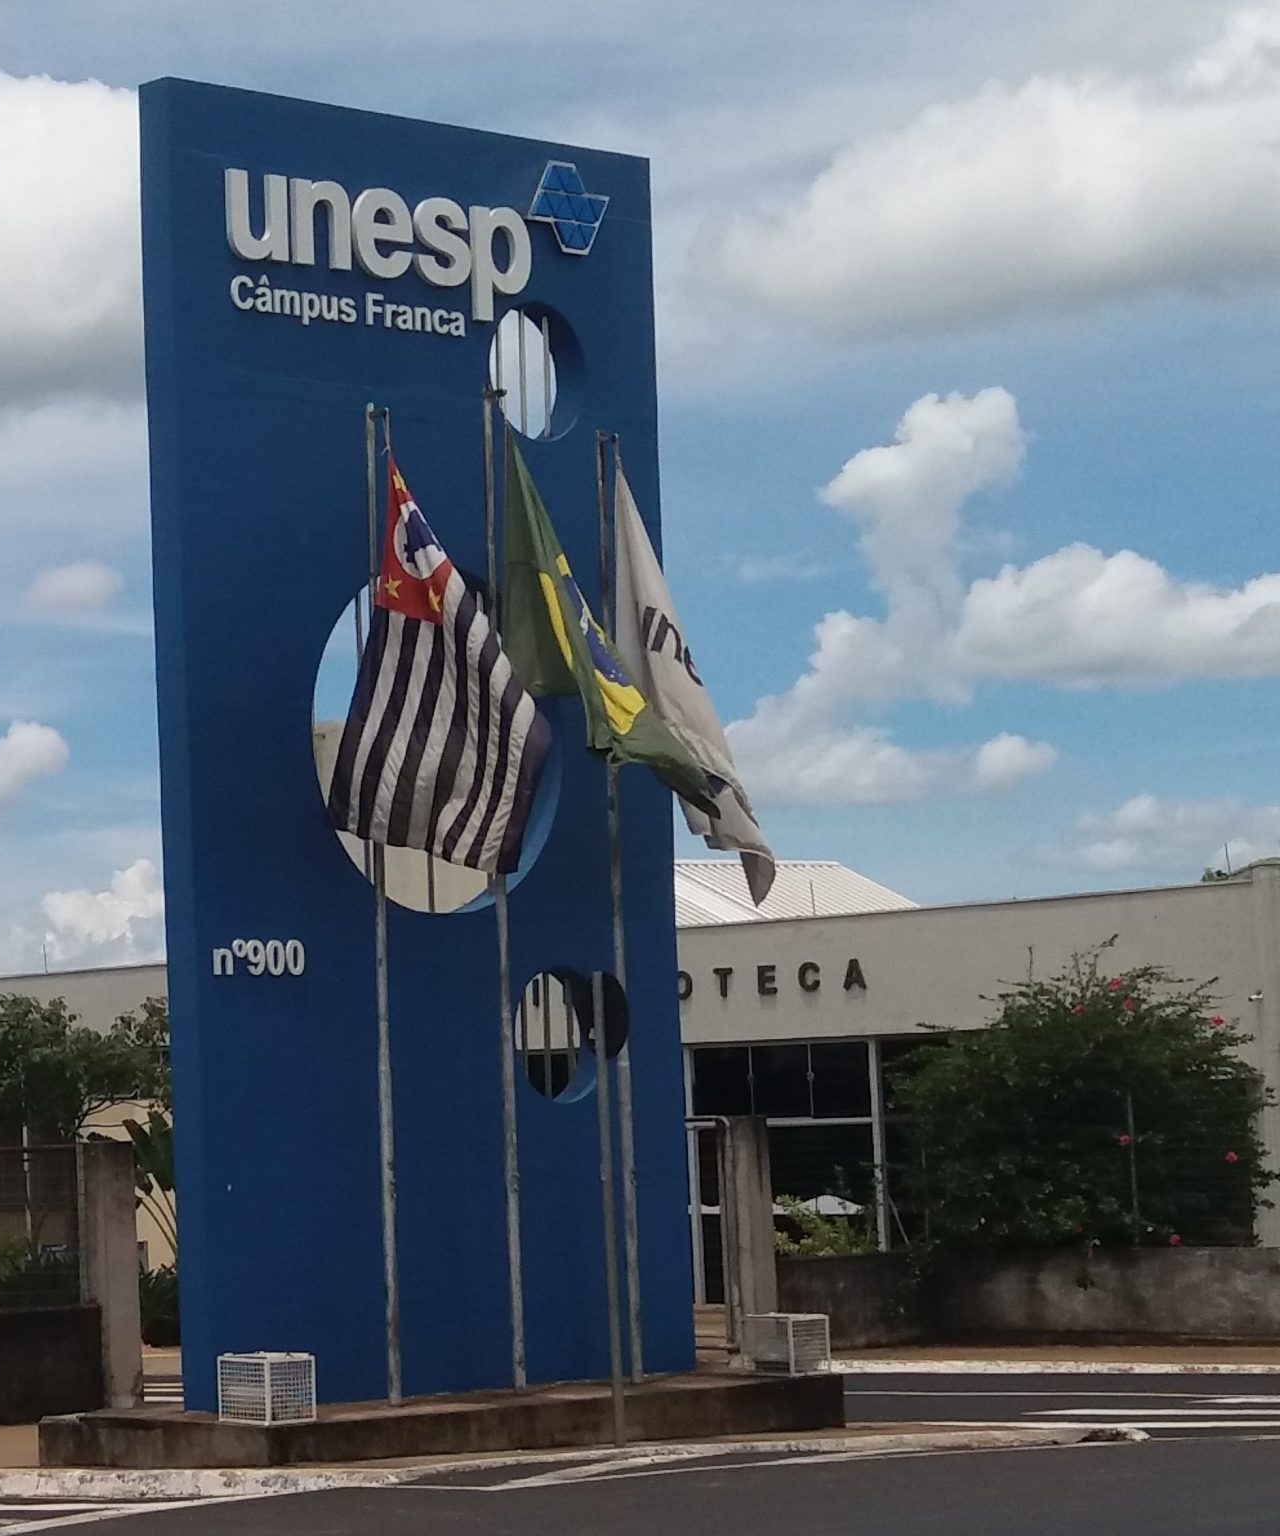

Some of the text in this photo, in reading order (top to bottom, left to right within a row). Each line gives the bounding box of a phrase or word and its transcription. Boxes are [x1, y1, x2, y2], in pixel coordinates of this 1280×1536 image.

[224, 168, 532, 321] unesp
[230, 274, 466, 337] Câmpus Franca
